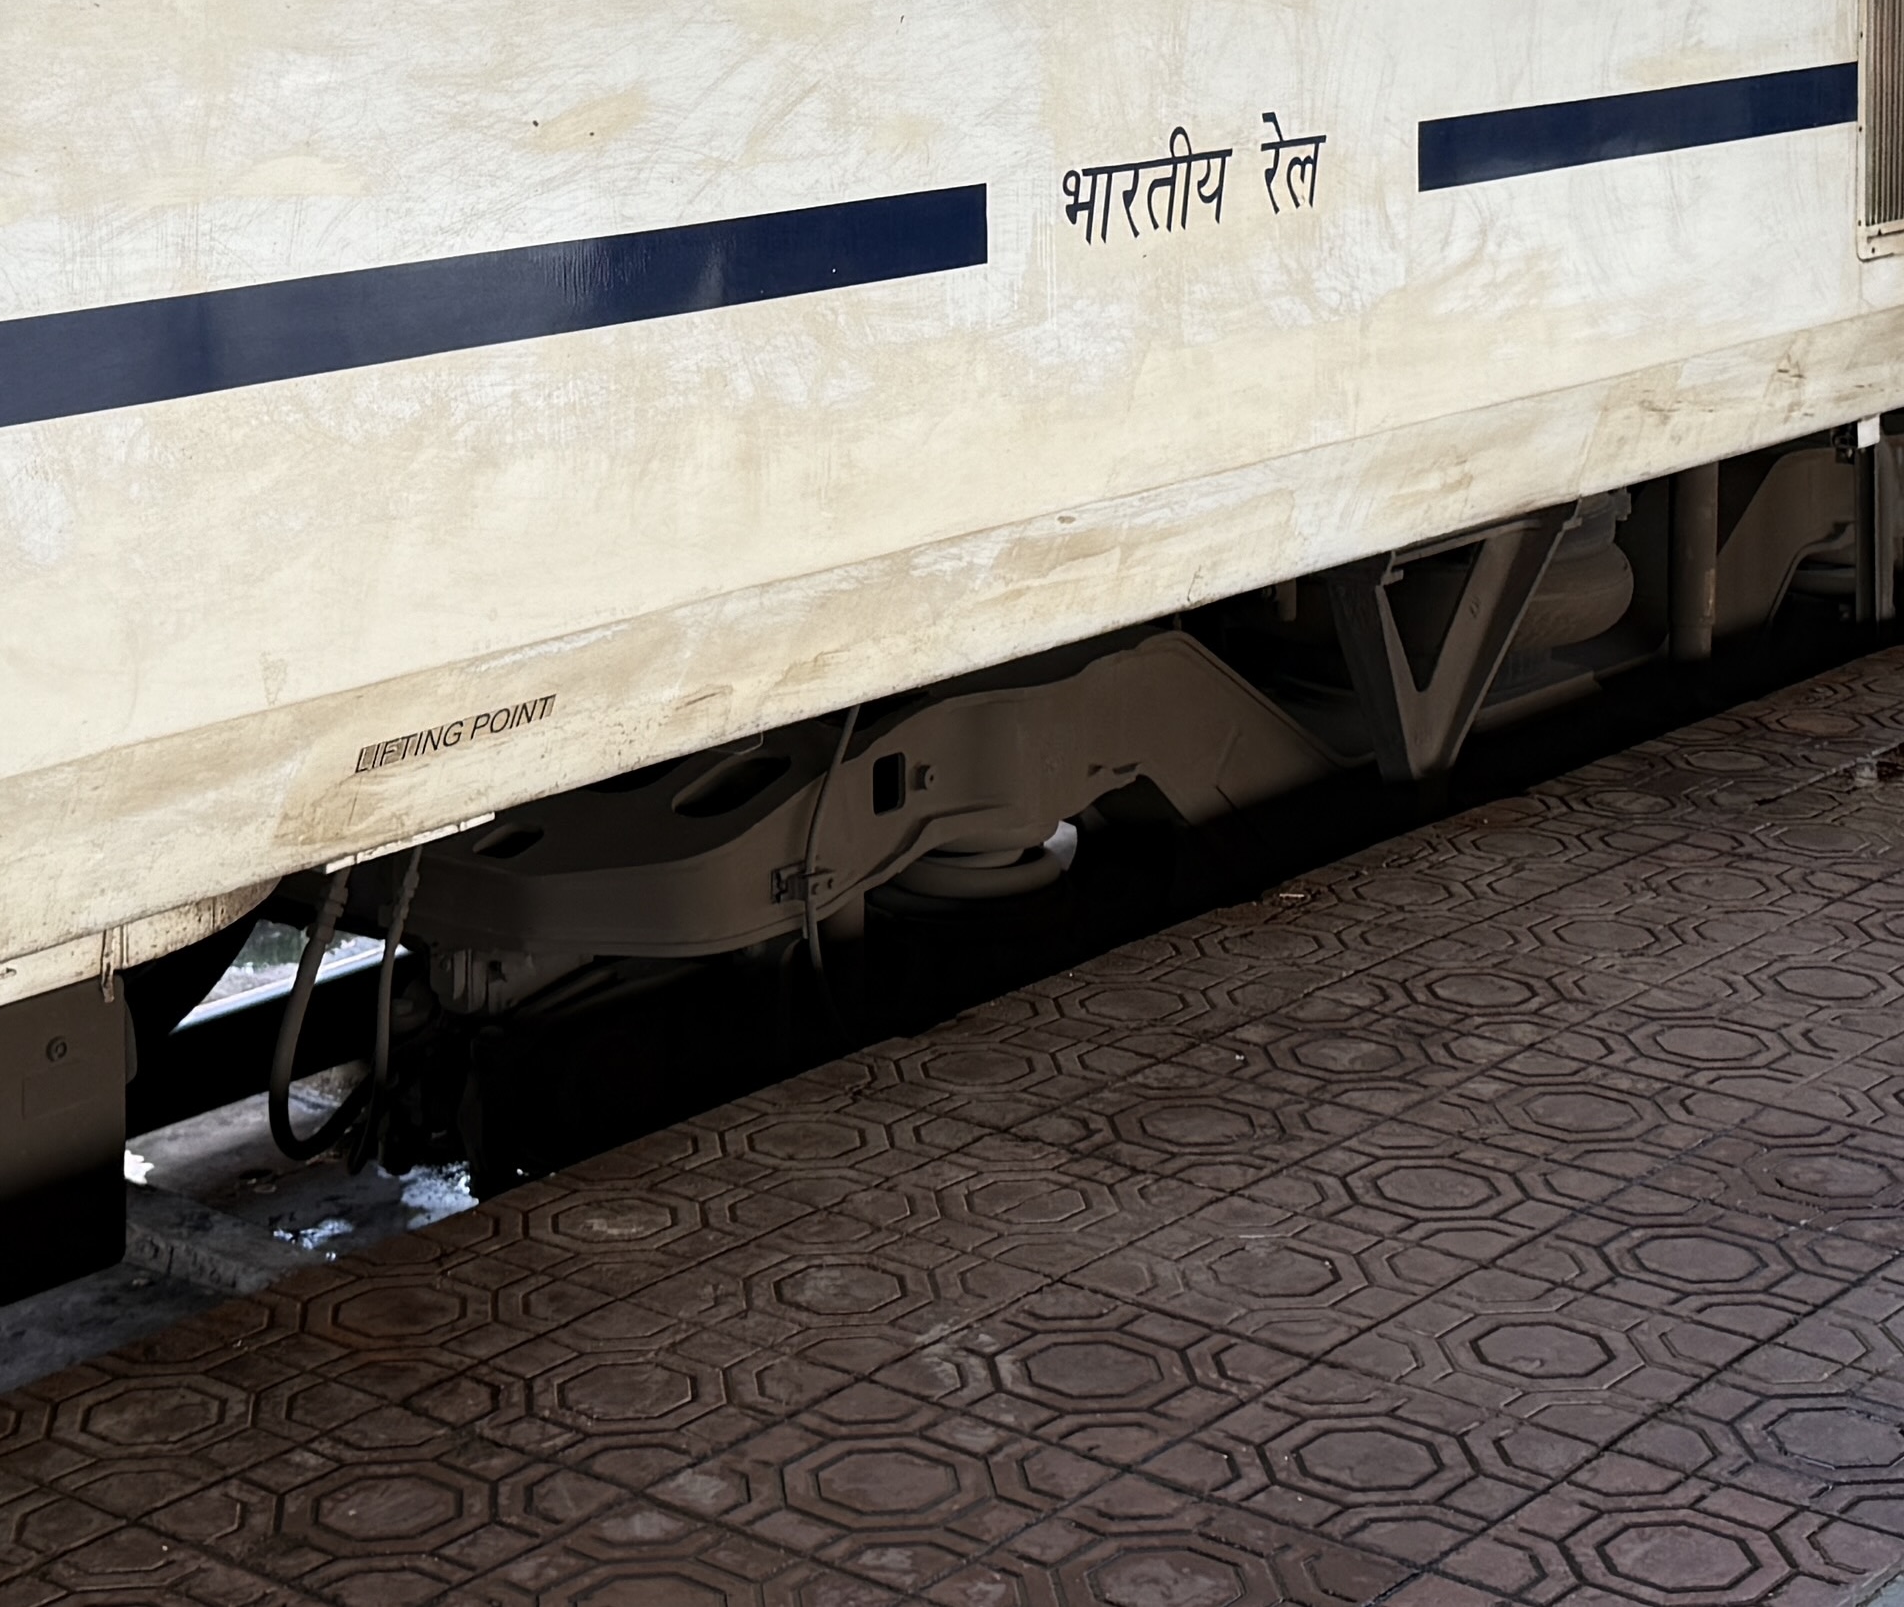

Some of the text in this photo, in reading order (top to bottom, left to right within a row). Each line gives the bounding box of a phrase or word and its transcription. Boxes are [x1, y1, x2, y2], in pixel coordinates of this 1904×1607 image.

[1062, 111, 1327, 245] भारतीय रेल
[354, 693, 557, 774] LIFTING POINT
